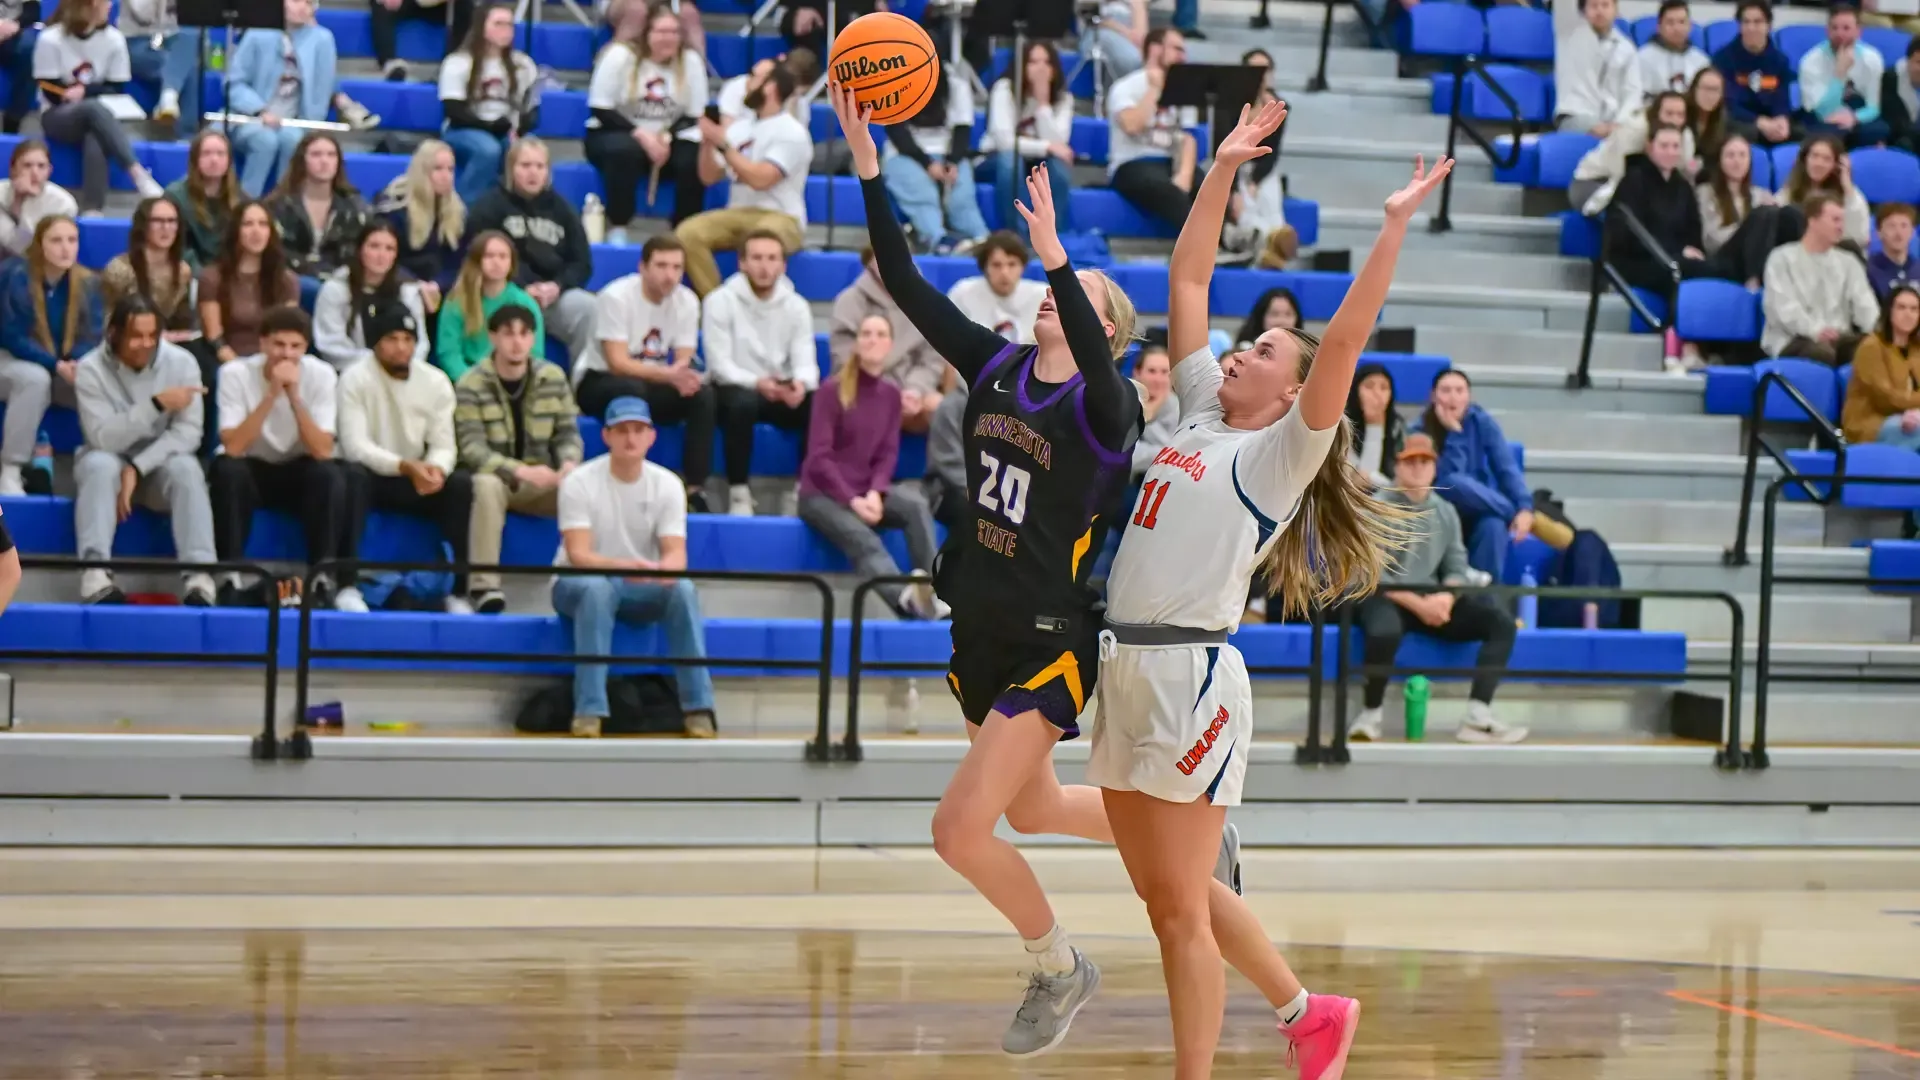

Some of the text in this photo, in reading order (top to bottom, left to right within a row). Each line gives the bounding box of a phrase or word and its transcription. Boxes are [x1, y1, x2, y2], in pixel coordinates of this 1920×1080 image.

[834, 54, 907, 84] Wilson
[978, 450, 1032, 525] 20
[1133, 478, 1171, 530] 11
[977, 518, 1018, 558] STATE
